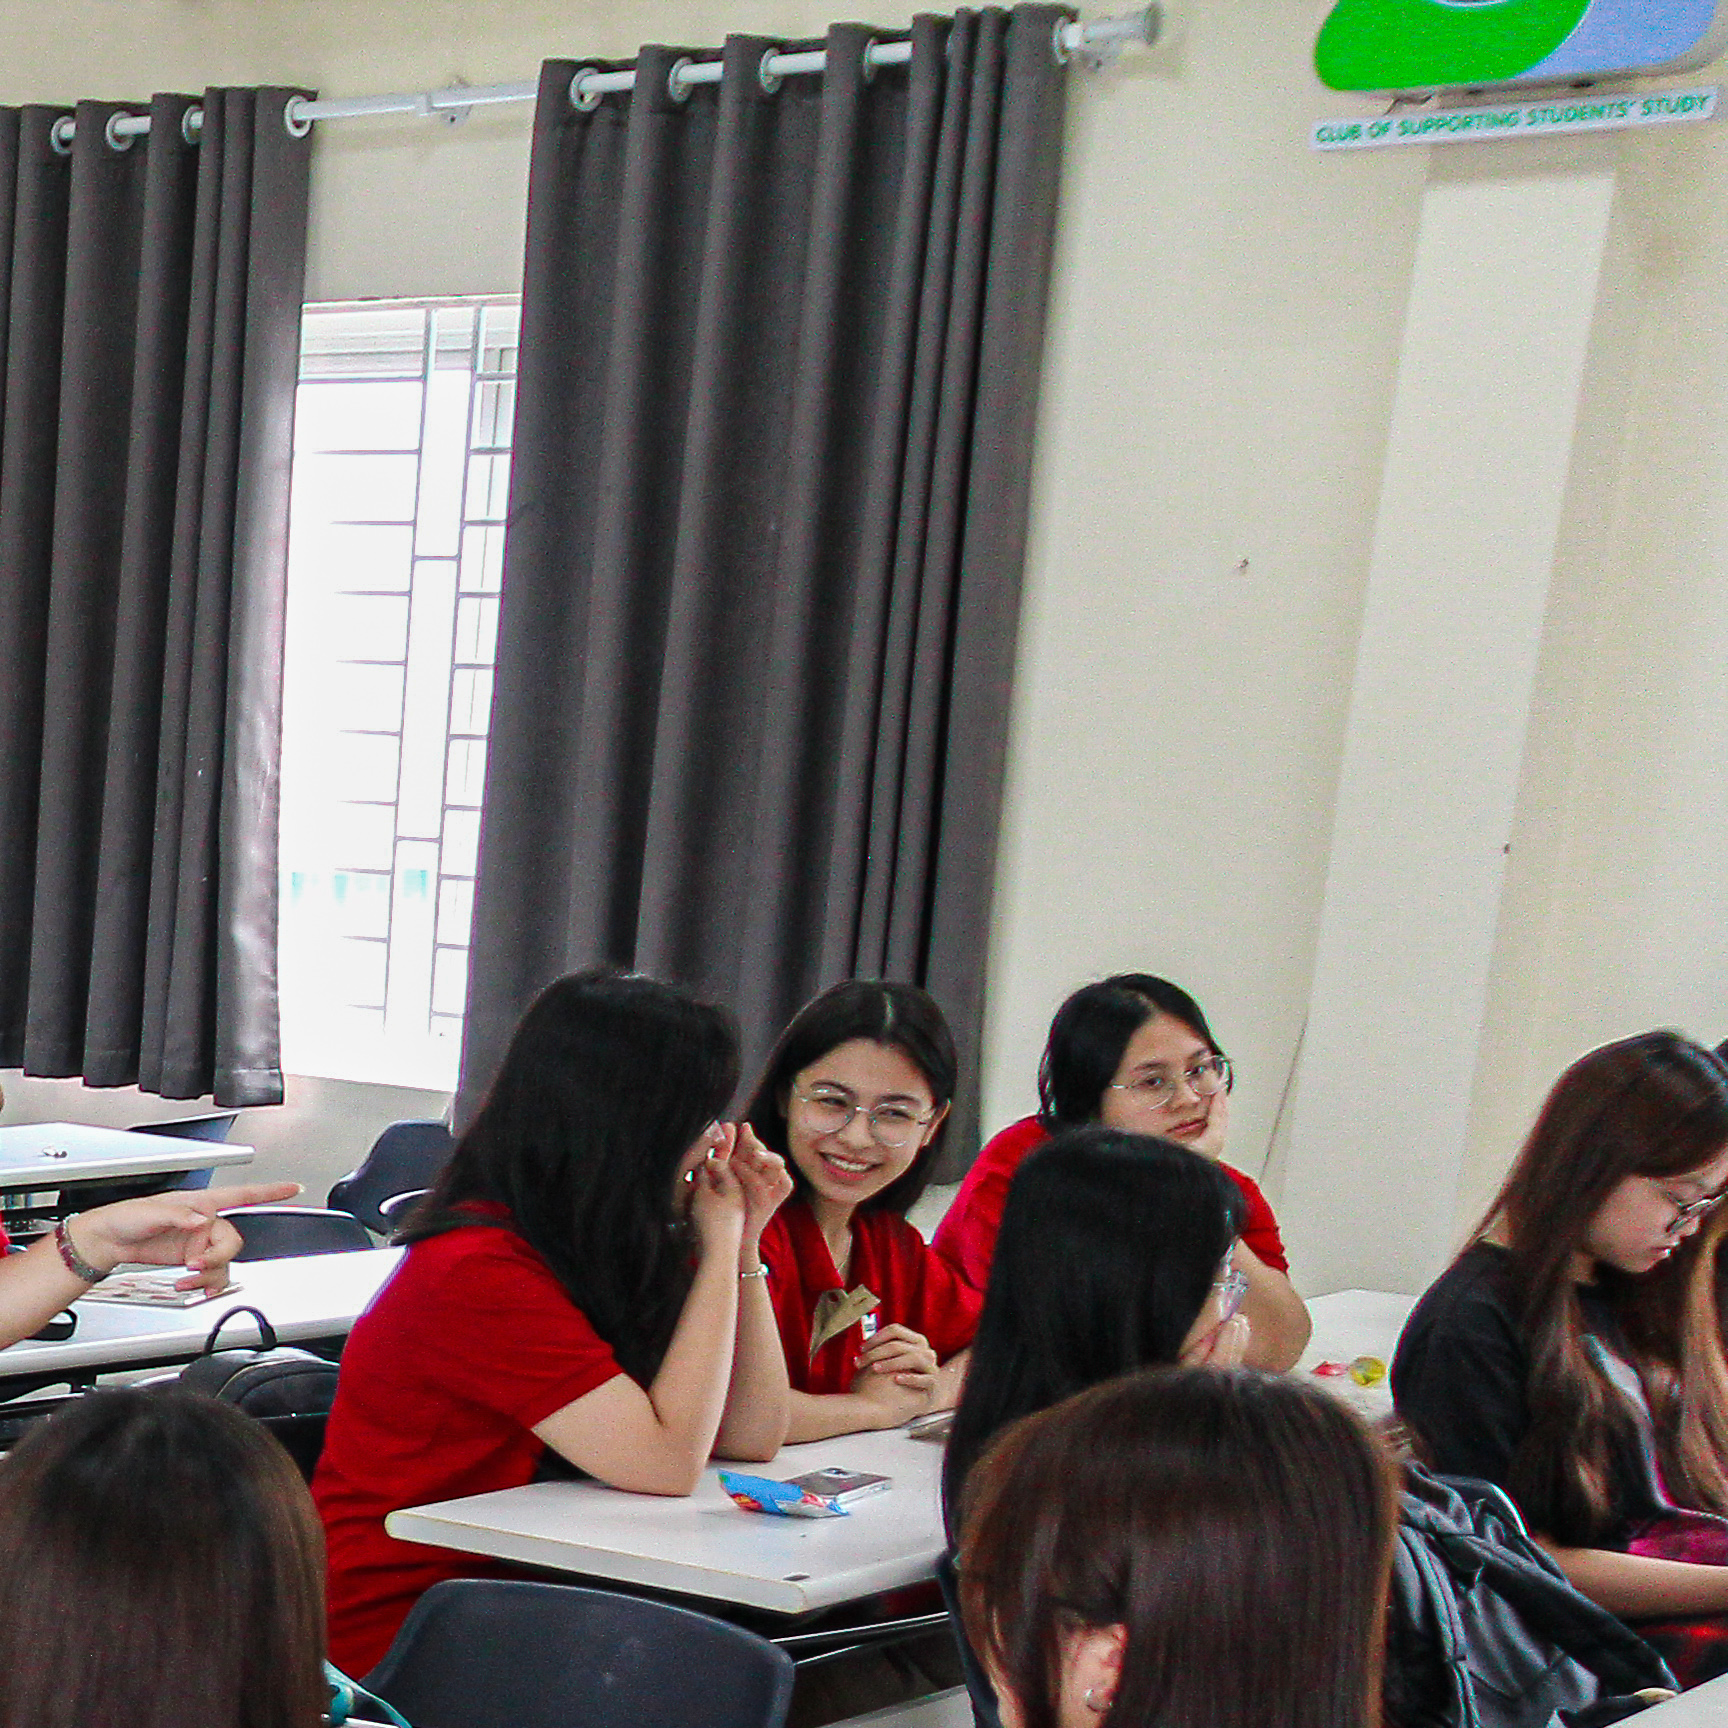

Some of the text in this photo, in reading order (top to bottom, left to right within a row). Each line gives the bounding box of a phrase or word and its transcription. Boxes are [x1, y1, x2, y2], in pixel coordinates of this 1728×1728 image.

[1316, 124, 1362, 142] CLUB
[1367, 121, 1392, 138] OF
[1398, 110, 1519, 136] SUPPORTING
[1641, 95, 1710, 116] STUDY
